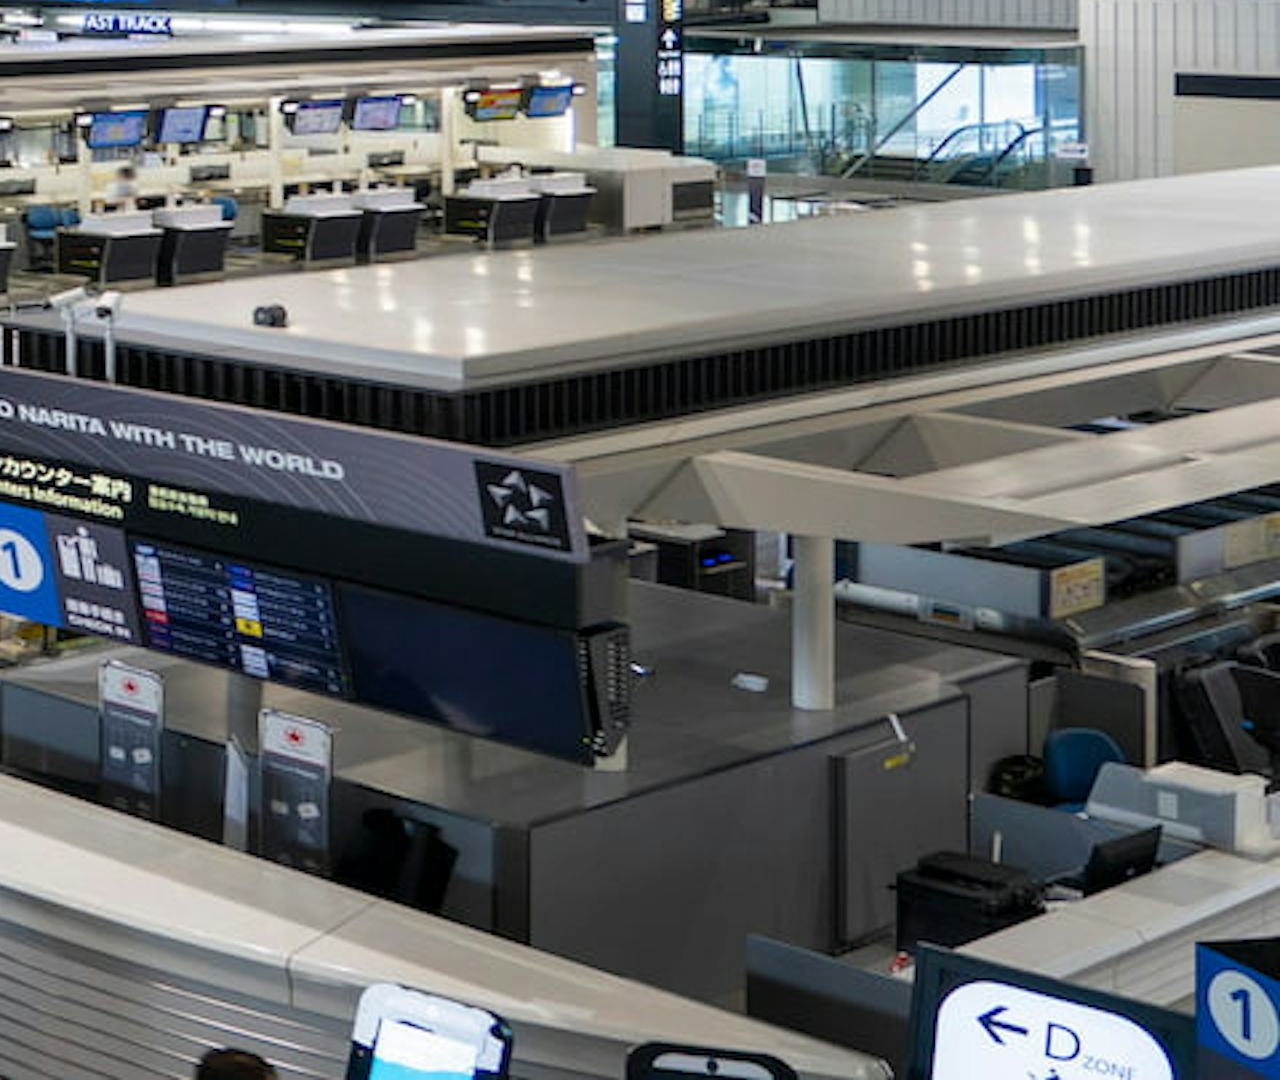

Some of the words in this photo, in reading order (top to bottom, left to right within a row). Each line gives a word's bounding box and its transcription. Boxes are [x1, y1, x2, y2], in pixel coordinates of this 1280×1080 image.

[119, 15, 172, 32] TRACK
[17, 404, 106, 437] NARITA
[109, 420, 176, 450] WITH
[179, 433, 236, 460] THE
[238, 445, 345, 481] WORLD
[32, 483, 125, 520] Information
[0, 540, 22, 580] 1
[1229, 989, 1252, 1042] 1
[1045, 1022, 1081, 1061] D
